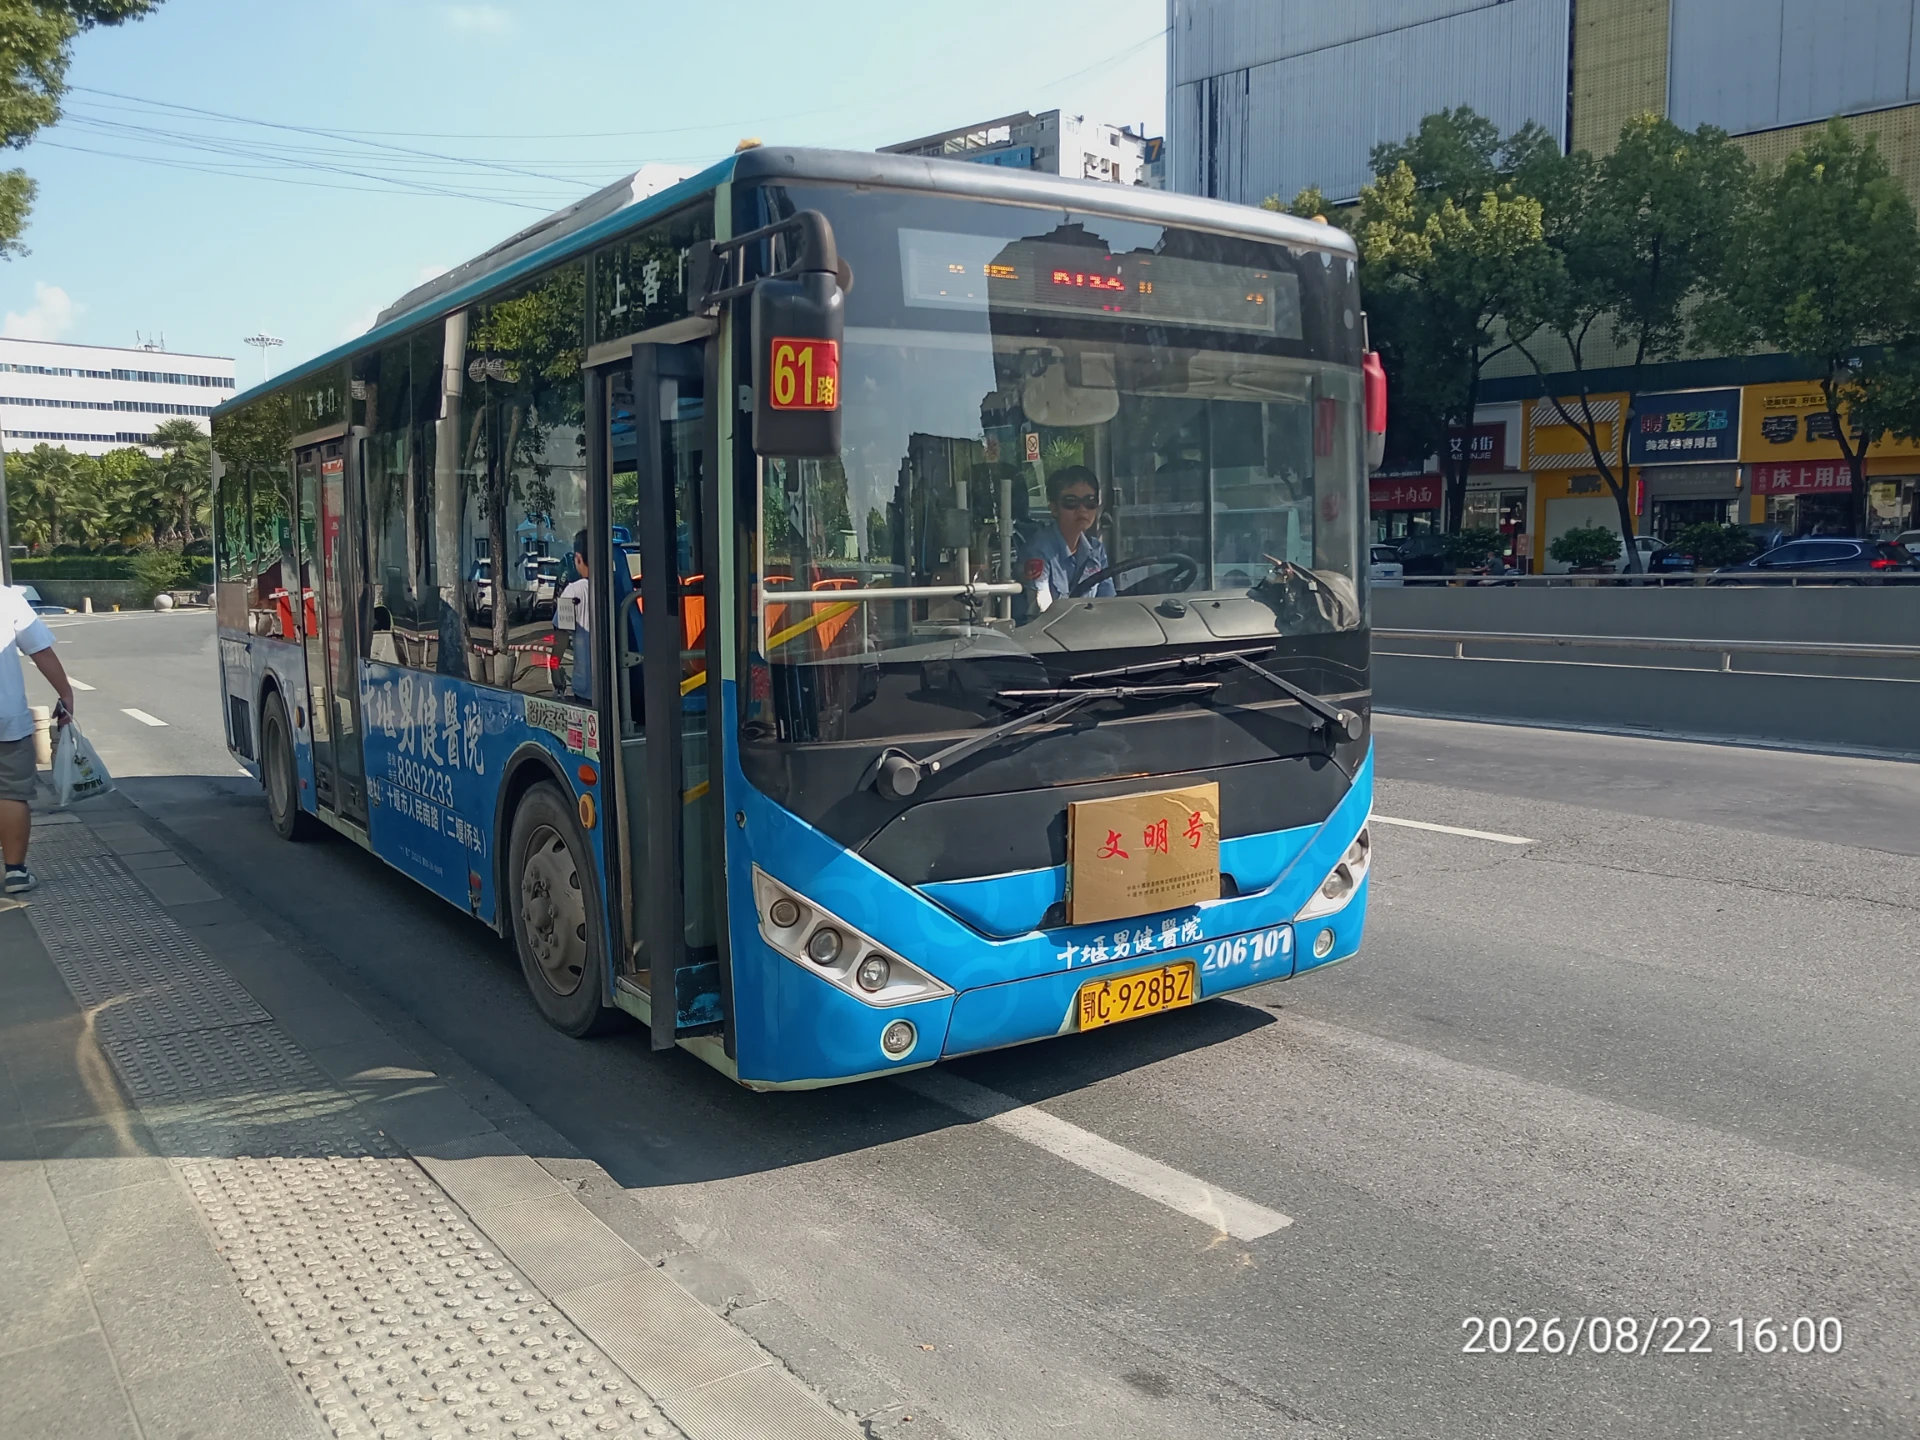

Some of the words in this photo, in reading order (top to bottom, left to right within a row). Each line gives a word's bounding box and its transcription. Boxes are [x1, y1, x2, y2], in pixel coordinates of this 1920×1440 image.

[774, 344, 836, 406] 61路
[1391, 486, 1432, 505] 牛肉面
[1772, 467, 1853, 489] 床上用品
[397, 755, 454, 809] 8892233
[1096, 811, 1204, 860] 文明号
[1056, 915, 1205, 970] 十堰男健醫院
[1202, 926, 1292, 972] 206101
